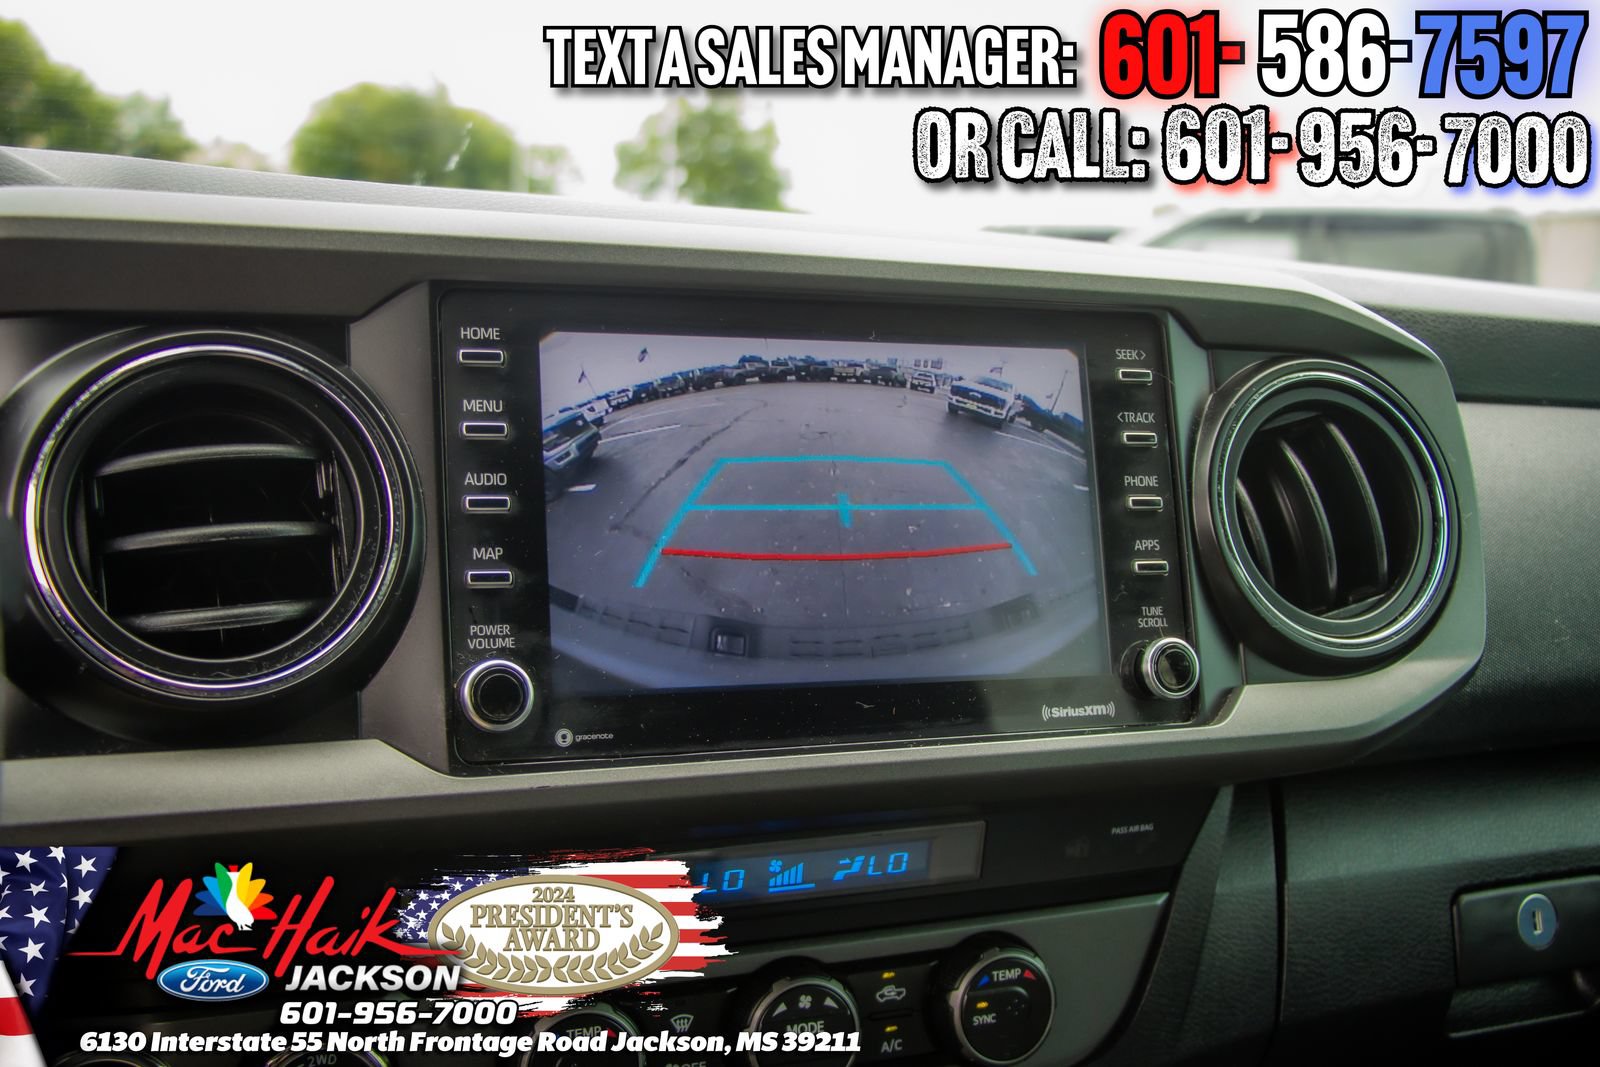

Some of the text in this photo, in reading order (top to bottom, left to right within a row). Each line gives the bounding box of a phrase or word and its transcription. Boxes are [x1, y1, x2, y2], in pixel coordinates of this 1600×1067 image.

[460, 327, 501, 340] HOME
[463, 399, 503, 412] MENU
[464, 473, 508, 486] AUDIO
[1124, 475, 1159, 487] PHONE
[1134, 539, 1160, 551] APPS
[472, 547, 504, 560] MAP
[1141, 606, 1164, 616] TUNE
[1138, 617, 1168, 628] SCROLL
[470, 624, 511, 636] POWER
[467, 637, 516, 649] VOLUME
[575, 732, 614, 742] gracenote
[1111, 822, 1154, 835] PASS AIR BAG
[991, 967, 1022, 983] TEMP
[972, 1013, 997, 1026] SYNC
[786, 1020, 825, 1034] MODE
[881, 1039, 903, 1054] A/C
[307, 1053, 337, 1067] 2WD
